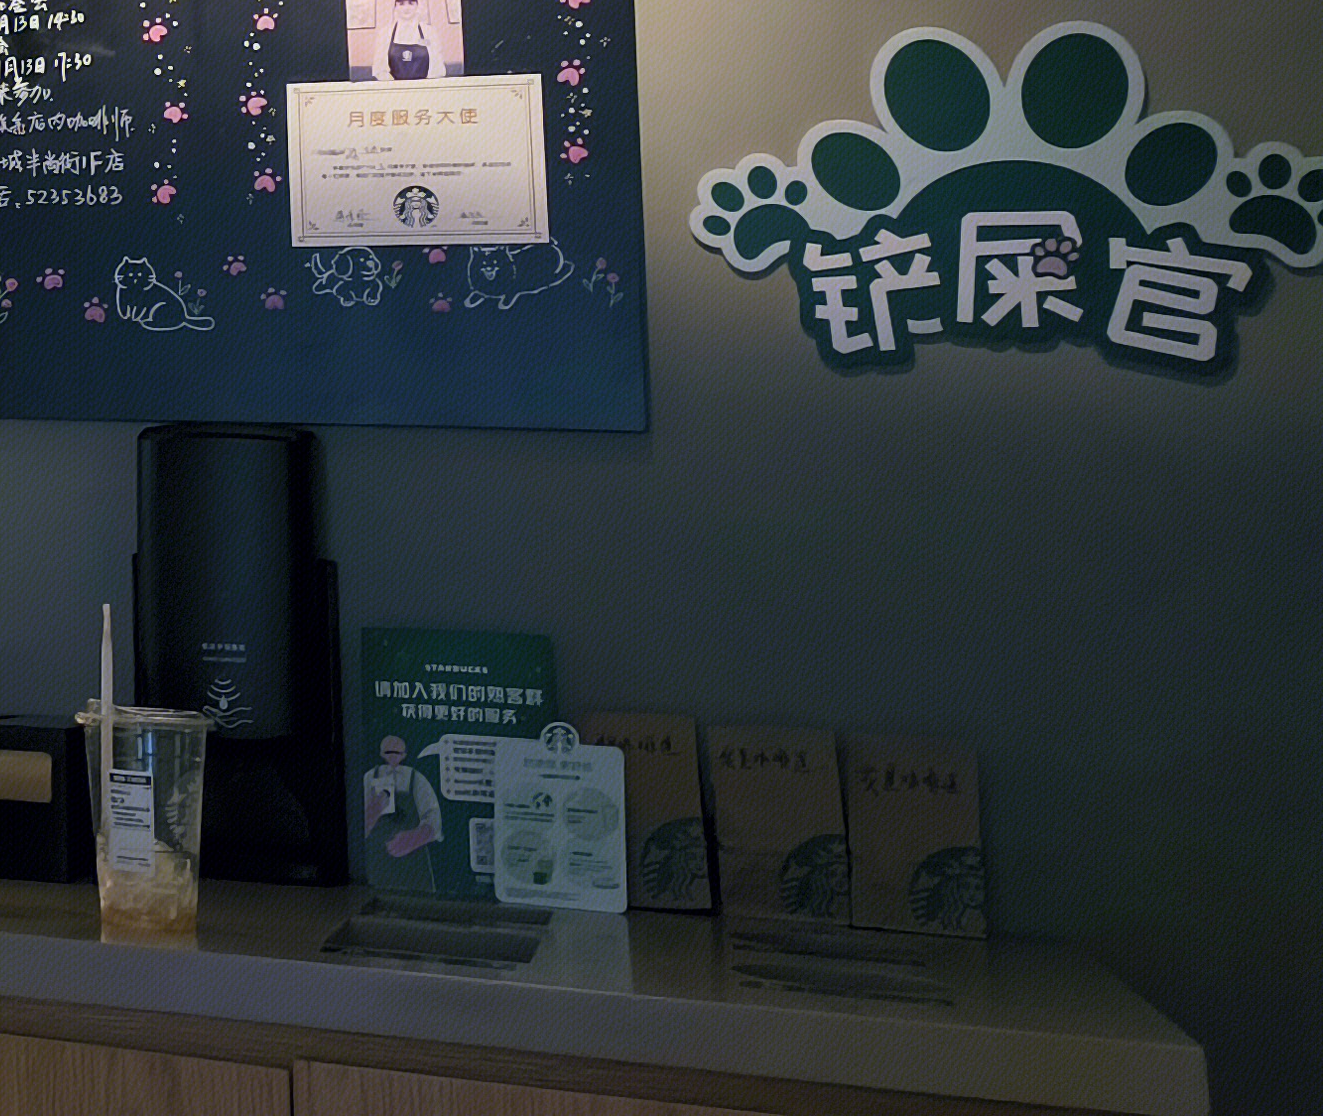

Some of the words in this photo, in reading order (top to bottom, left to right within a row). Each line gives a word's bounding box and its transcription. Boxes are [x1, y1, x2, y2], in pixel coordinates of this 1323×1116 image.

[347, 108, 481, 129] 月度服务大使
[803, 209, 1253, 362] 铲屎官
